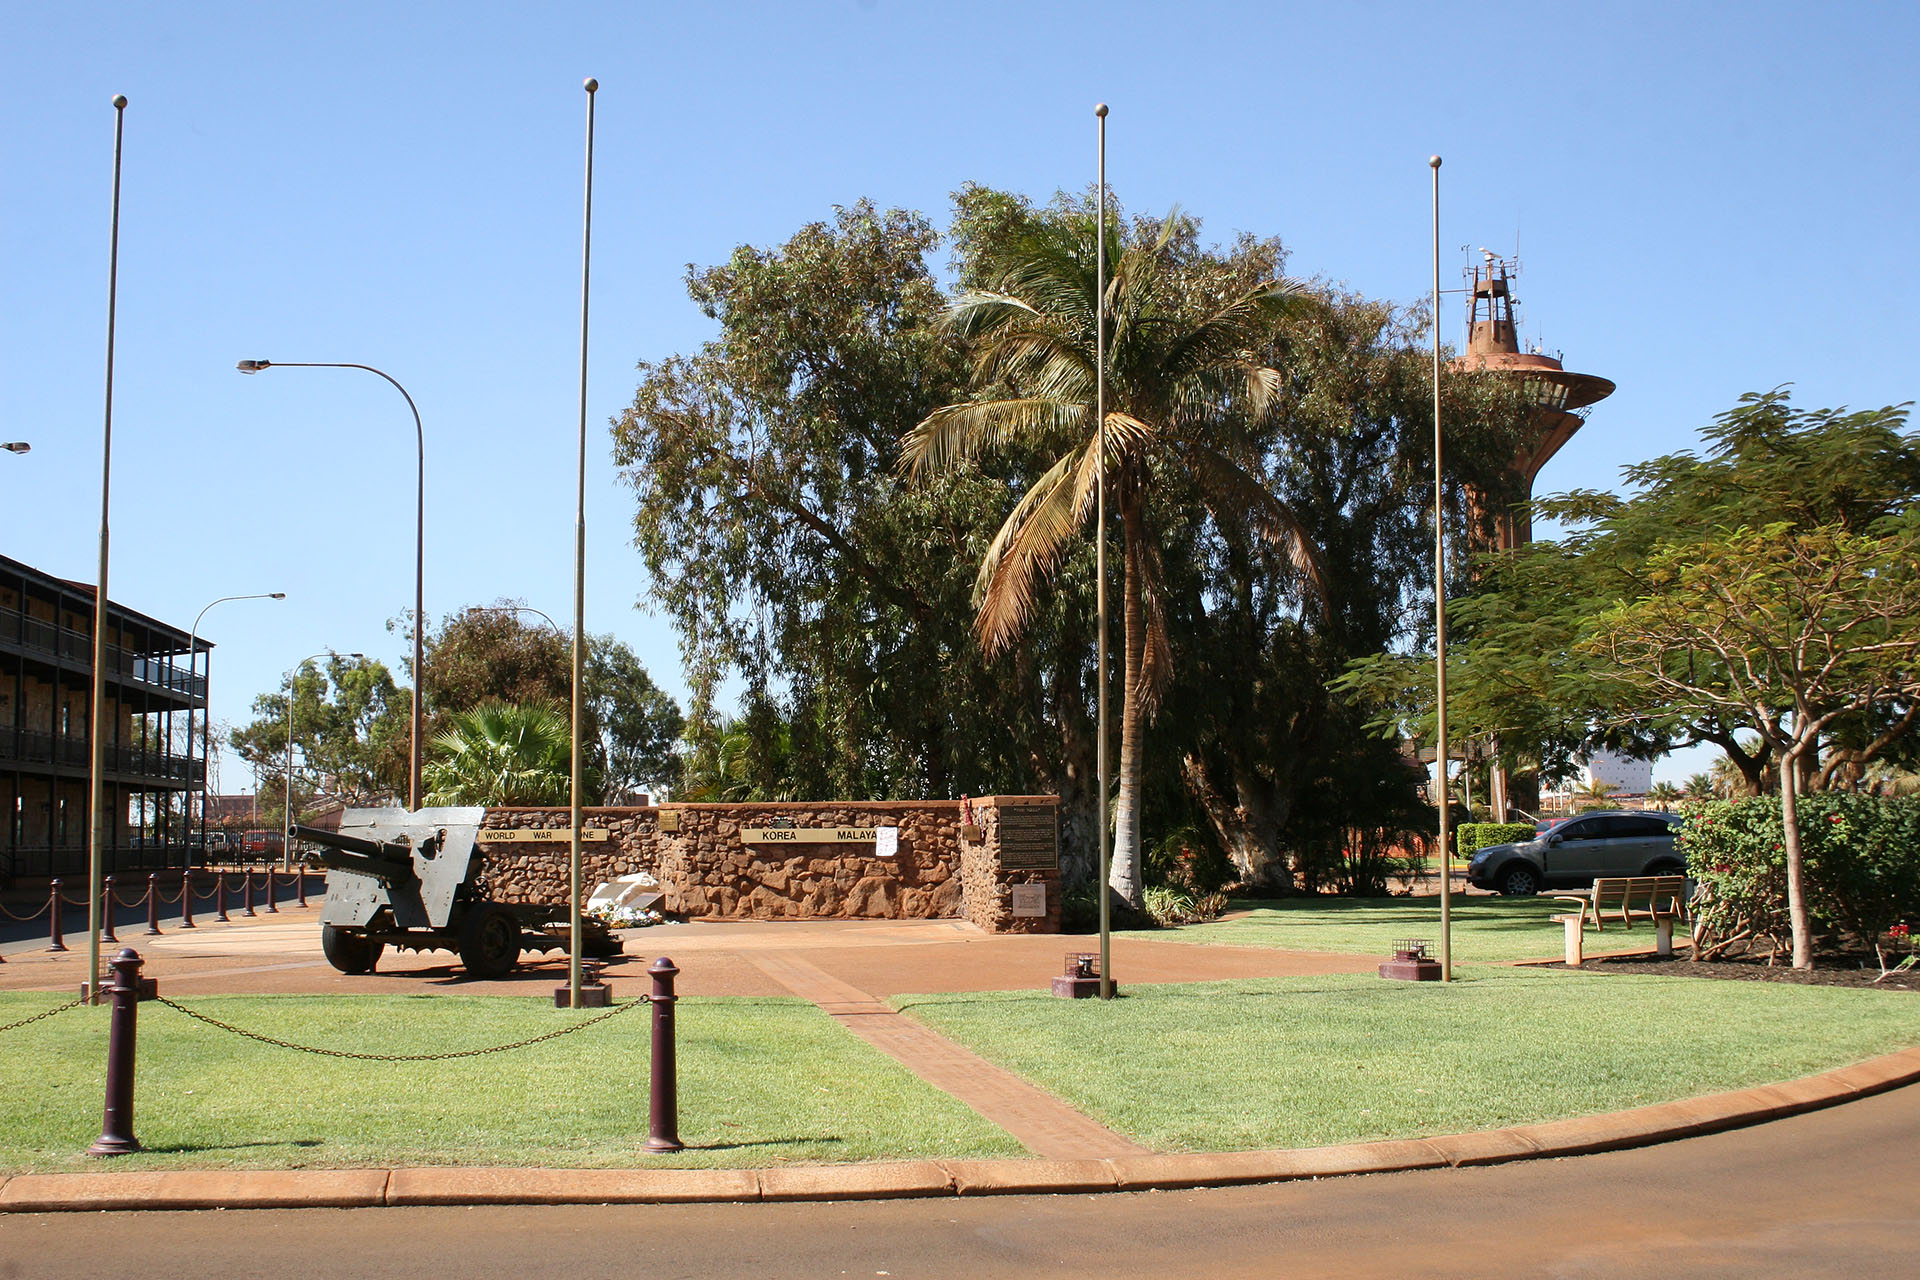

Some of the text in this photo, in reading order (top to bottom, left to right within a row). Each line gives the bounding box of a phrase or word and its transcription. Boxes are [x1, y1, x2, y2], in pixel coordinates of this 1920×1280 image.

[485, 831, 594, 840] WORLD WAR NE
[762, 831, 877, 840] KOREA MALAYA
